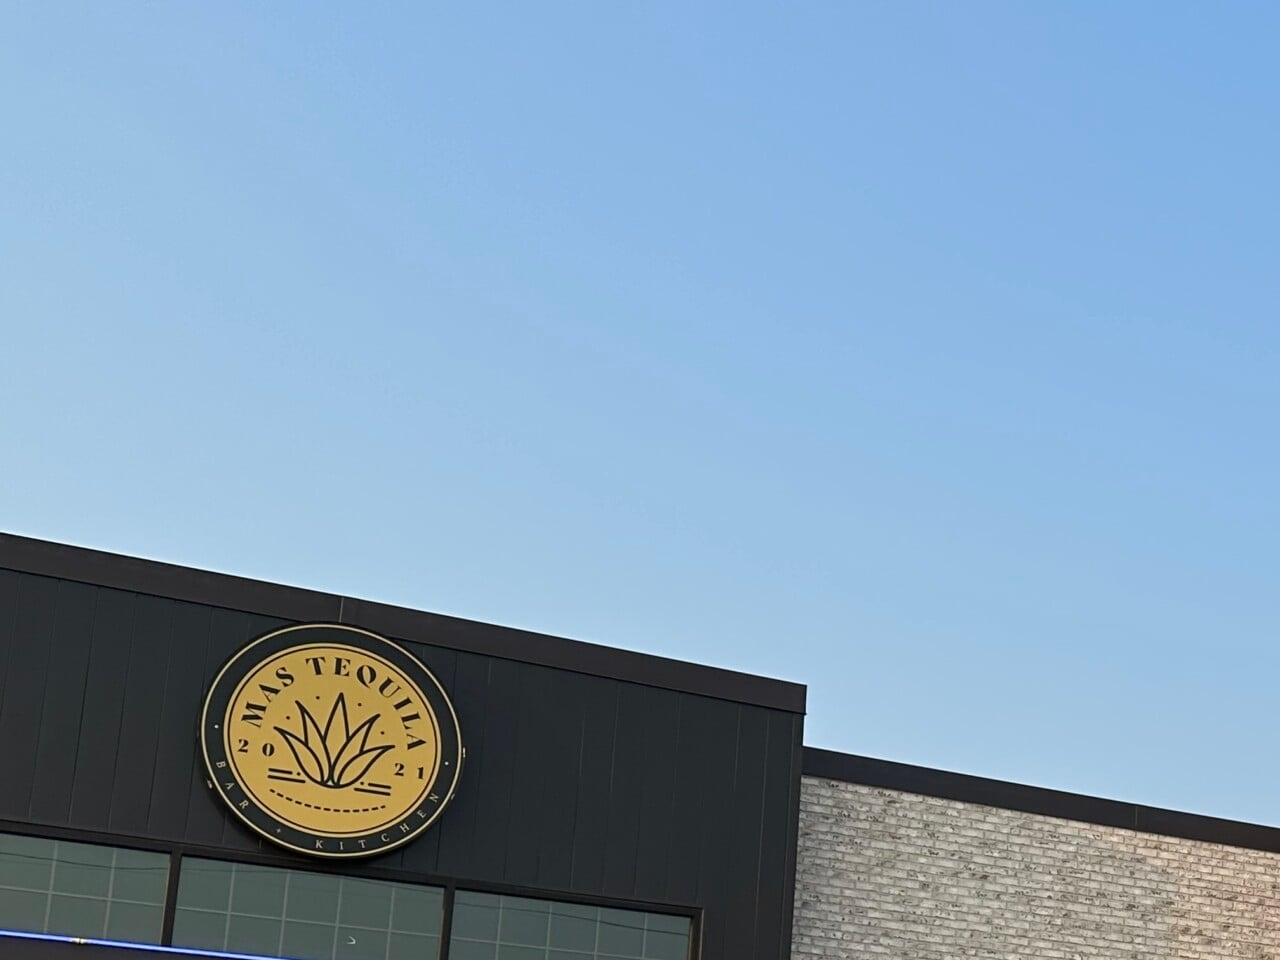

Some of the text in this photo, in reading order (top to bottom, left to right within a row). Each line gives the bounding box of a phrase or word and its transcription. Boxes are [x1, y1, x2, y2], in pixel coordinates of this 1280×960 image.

[241, 656, 427, 751] MAS TEQUILA
[216, 760, 249, 810] BAR
[315, 793, 440, 850] KITCHEN
